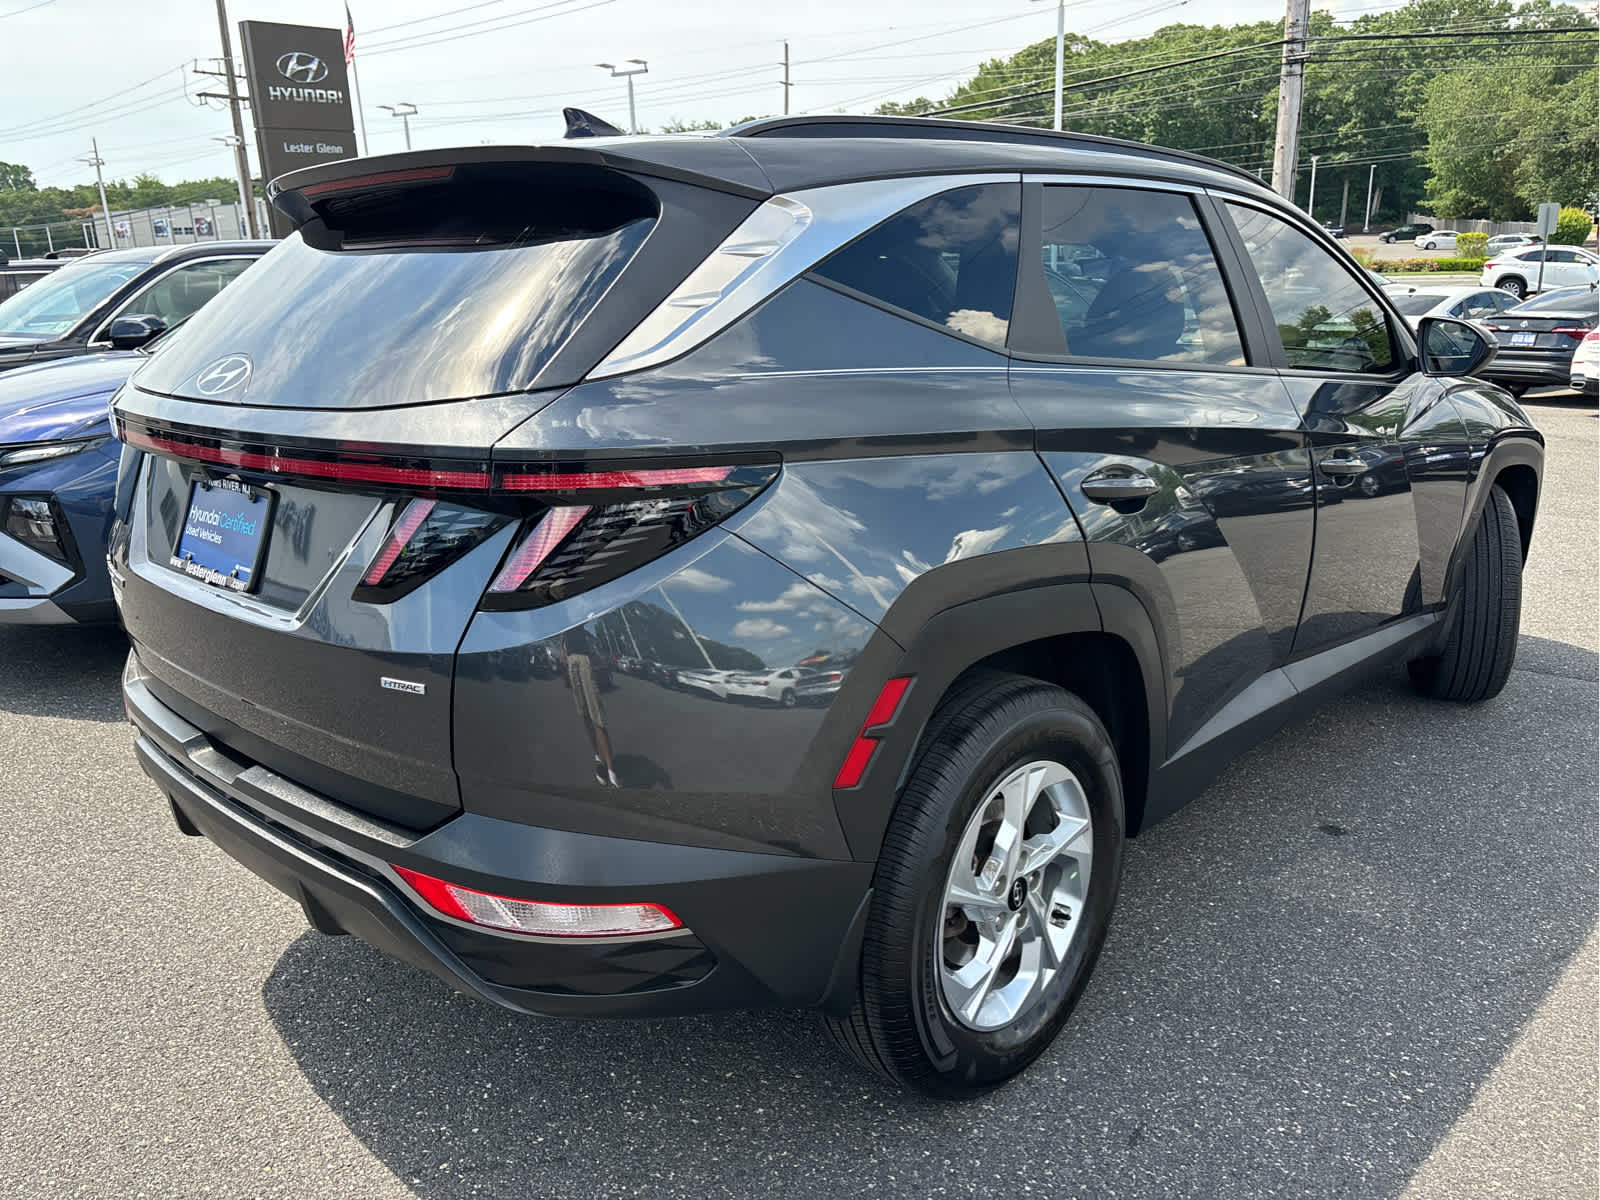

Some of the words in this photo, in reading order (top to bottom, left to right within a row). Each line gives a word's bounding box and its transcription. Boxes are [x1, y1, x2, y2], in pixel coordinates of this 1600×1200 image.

[268, 86, 344, 105] HYUNDAI
[283, 142, 314, 154] Lester
[316, 143, 344, 154] Glenn
[242, 484, 251, 495] NJ
[189, 504, 221, 527] Hyundai
[220, 511, 257, 536] Certified
[185, 523, 201, 538] Used
[200, 527, 223, 545] Vehicles
[383, 680, 421, 693] HTRAC
